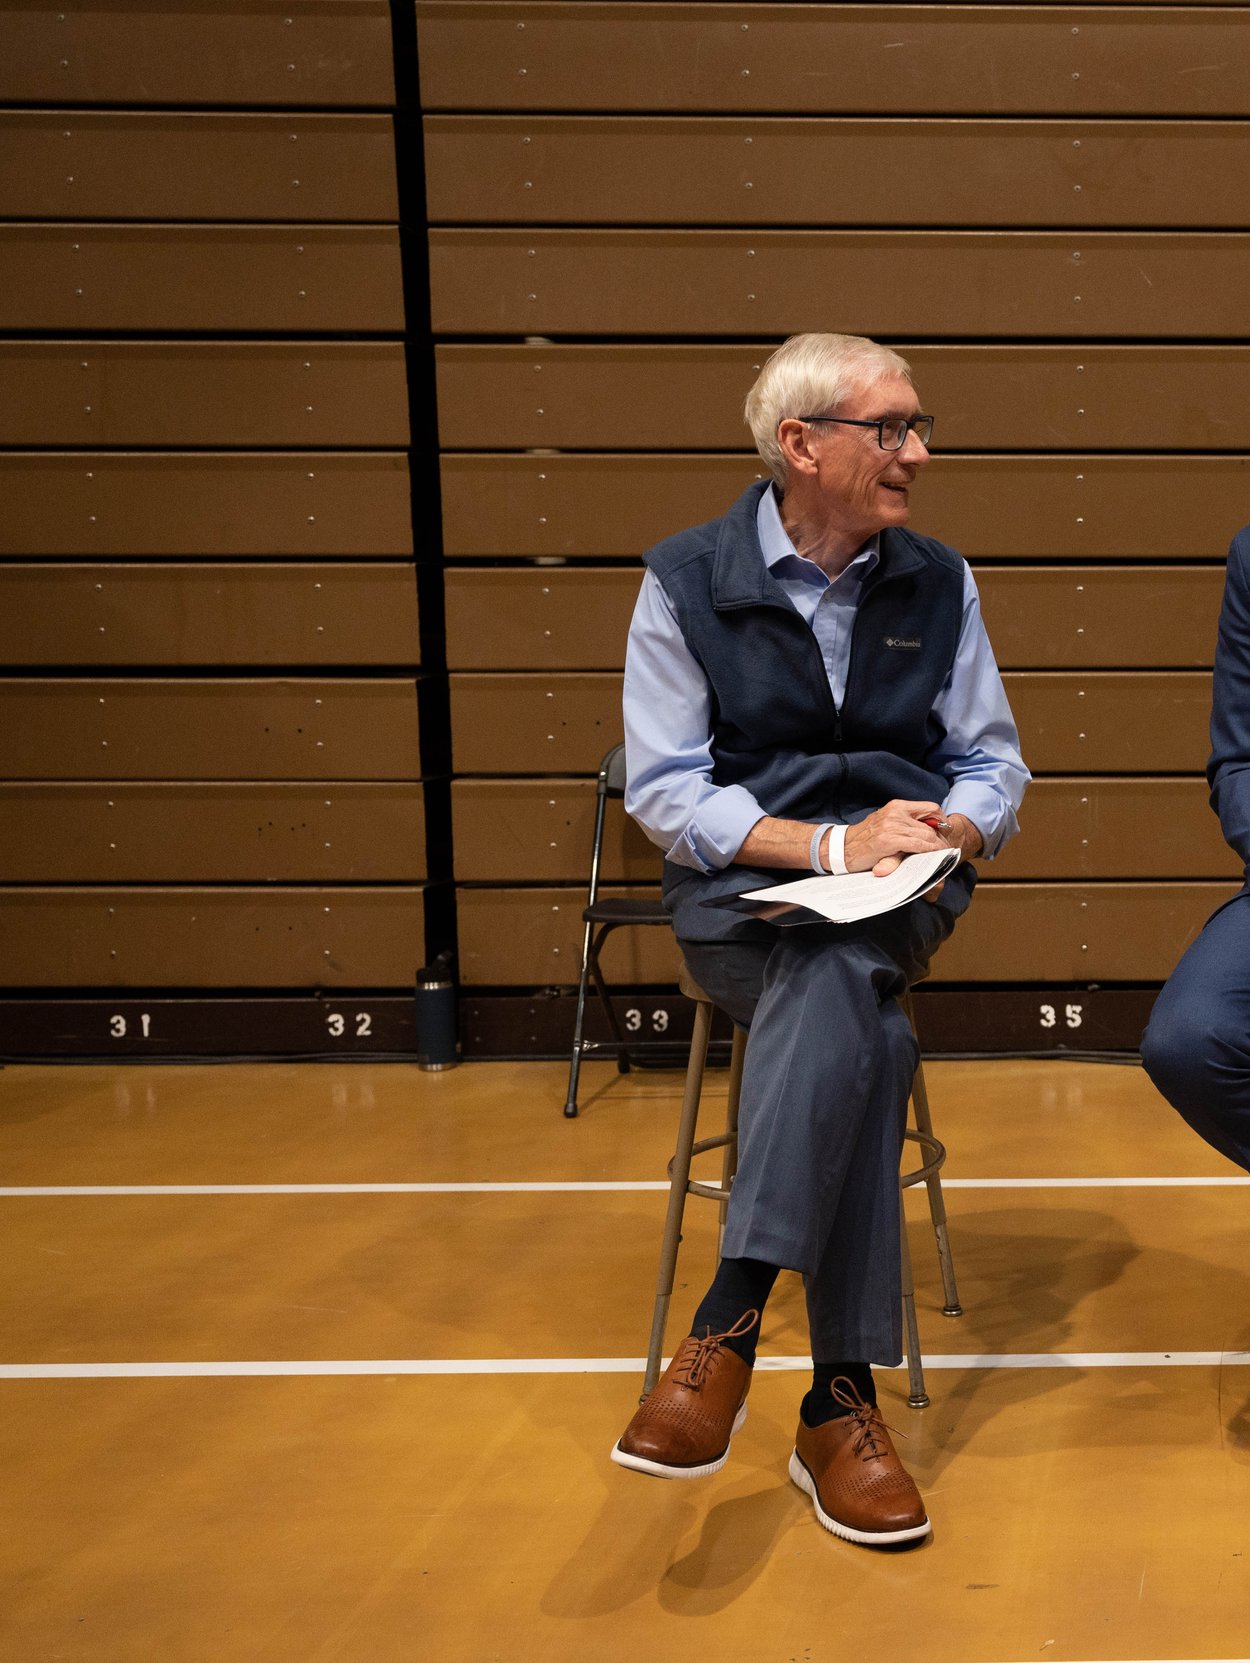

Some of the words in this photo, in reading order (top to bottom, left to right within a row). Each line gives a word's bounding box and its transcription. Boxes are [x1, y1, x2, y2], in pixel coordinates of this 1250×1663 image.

[893, 639, 921, 648] Columbia
[110, 1014, 151, 1038] 31
[327, 1013, 372, 1037] 32
[625, 1009, 669, 1032] 33
[1040, 1004, 1083, 1028] 35
